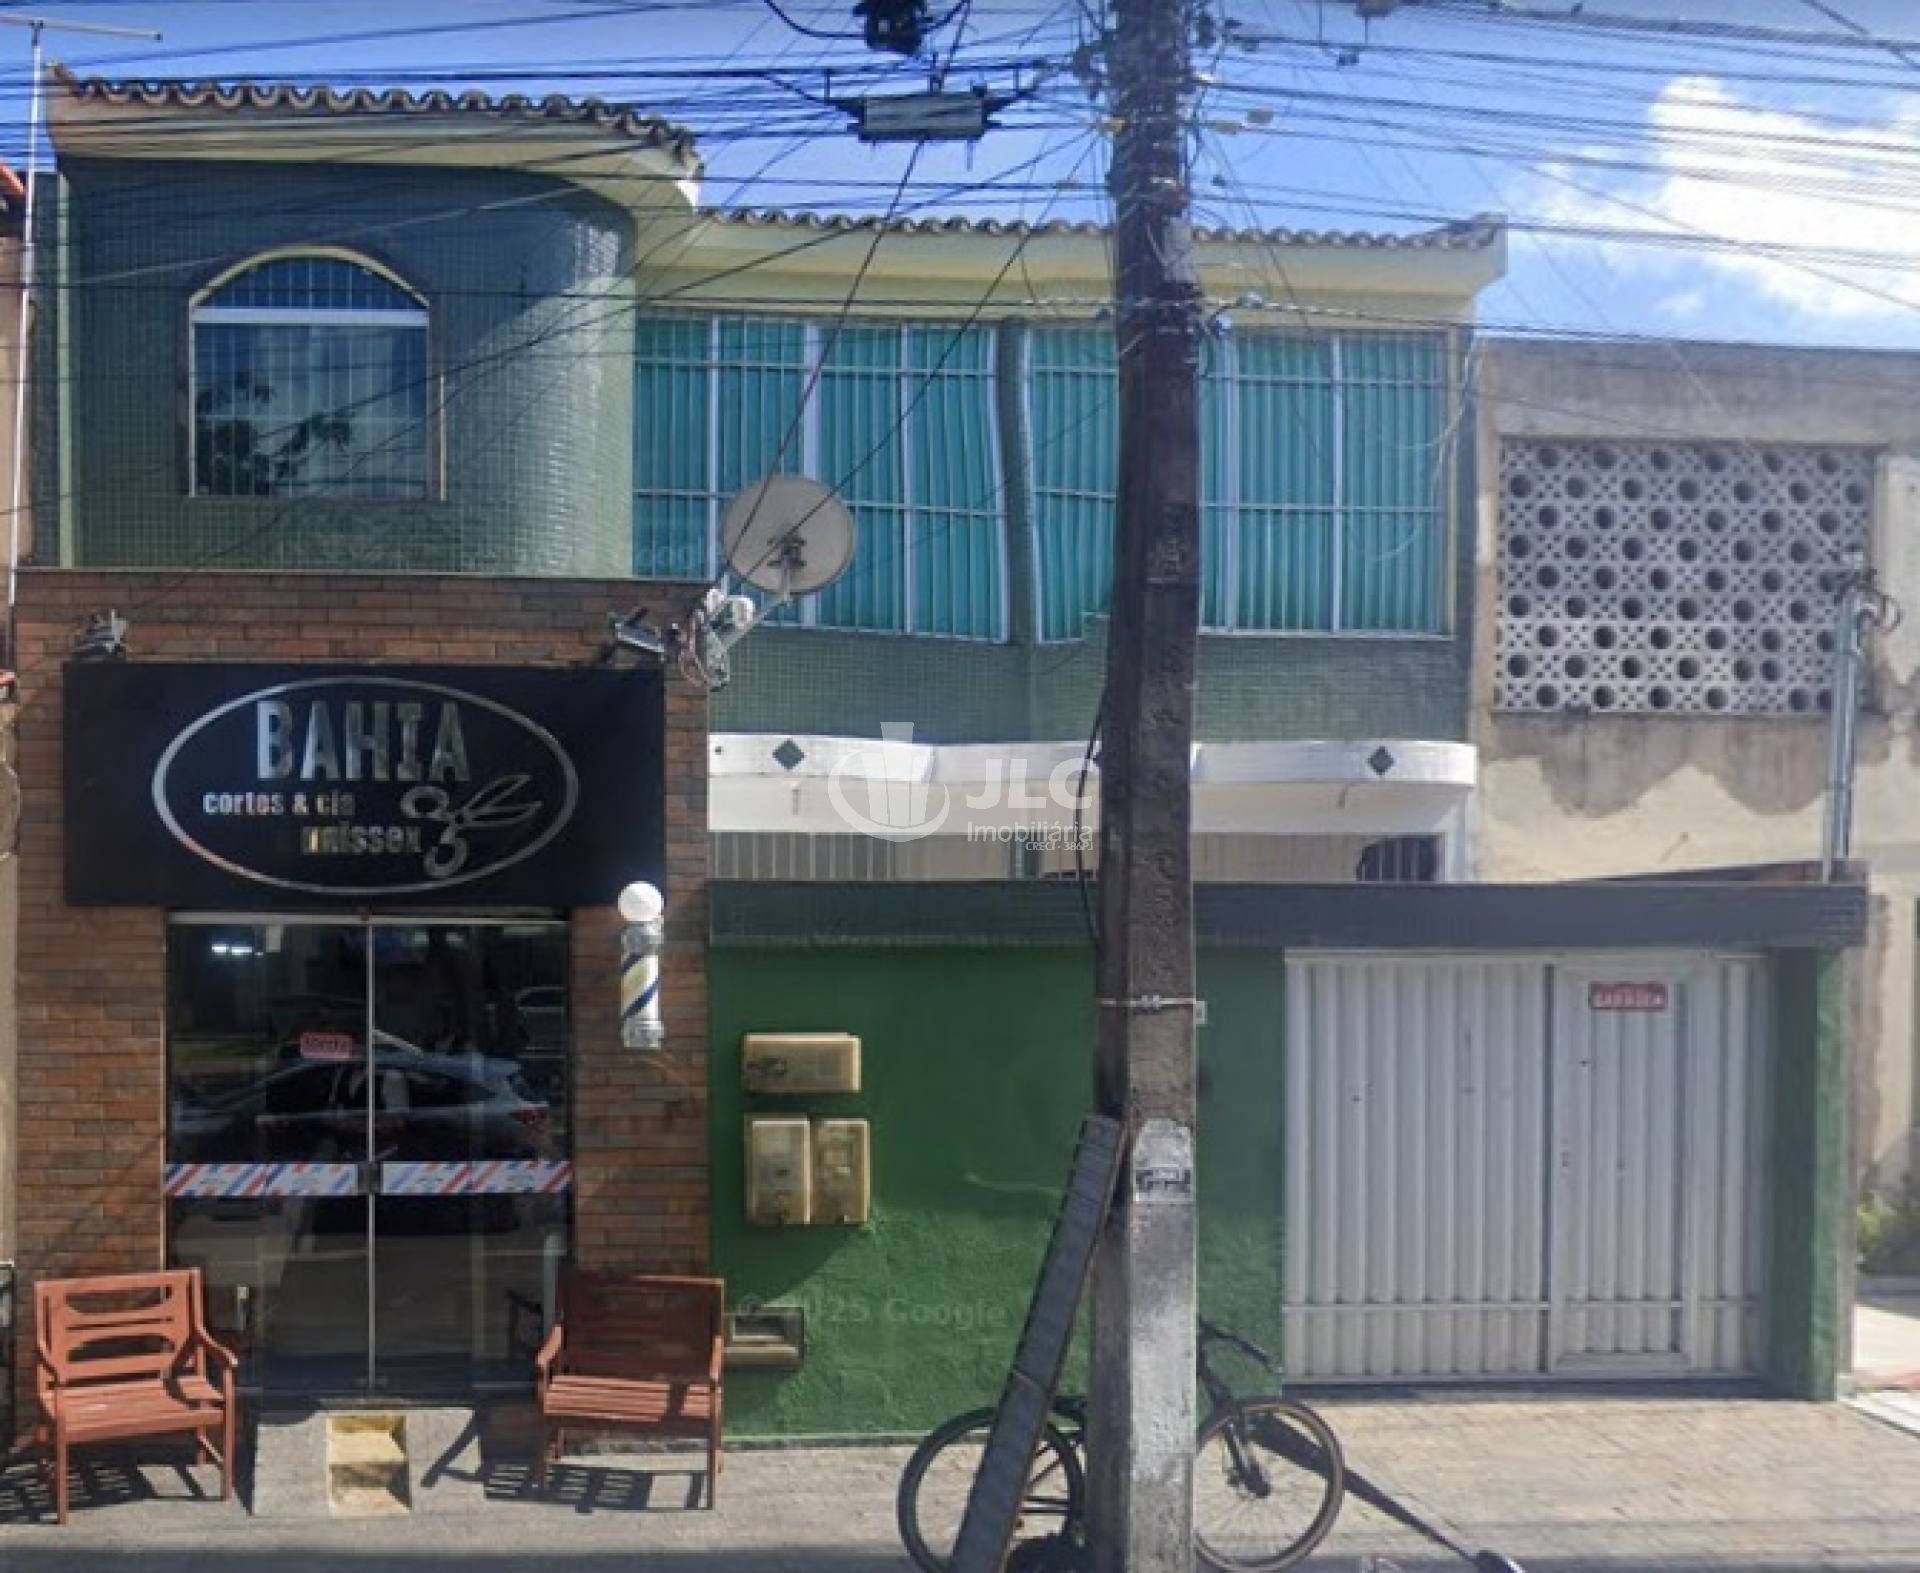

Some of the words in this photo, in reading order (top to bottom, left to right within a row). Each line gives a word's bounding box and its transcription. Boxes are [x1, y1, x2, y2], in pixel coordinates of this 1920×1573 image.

[256, 700, 470, 781] BAHIA
[202, 790, 284, 816] cortes
[291, 791, 310, 816] &
